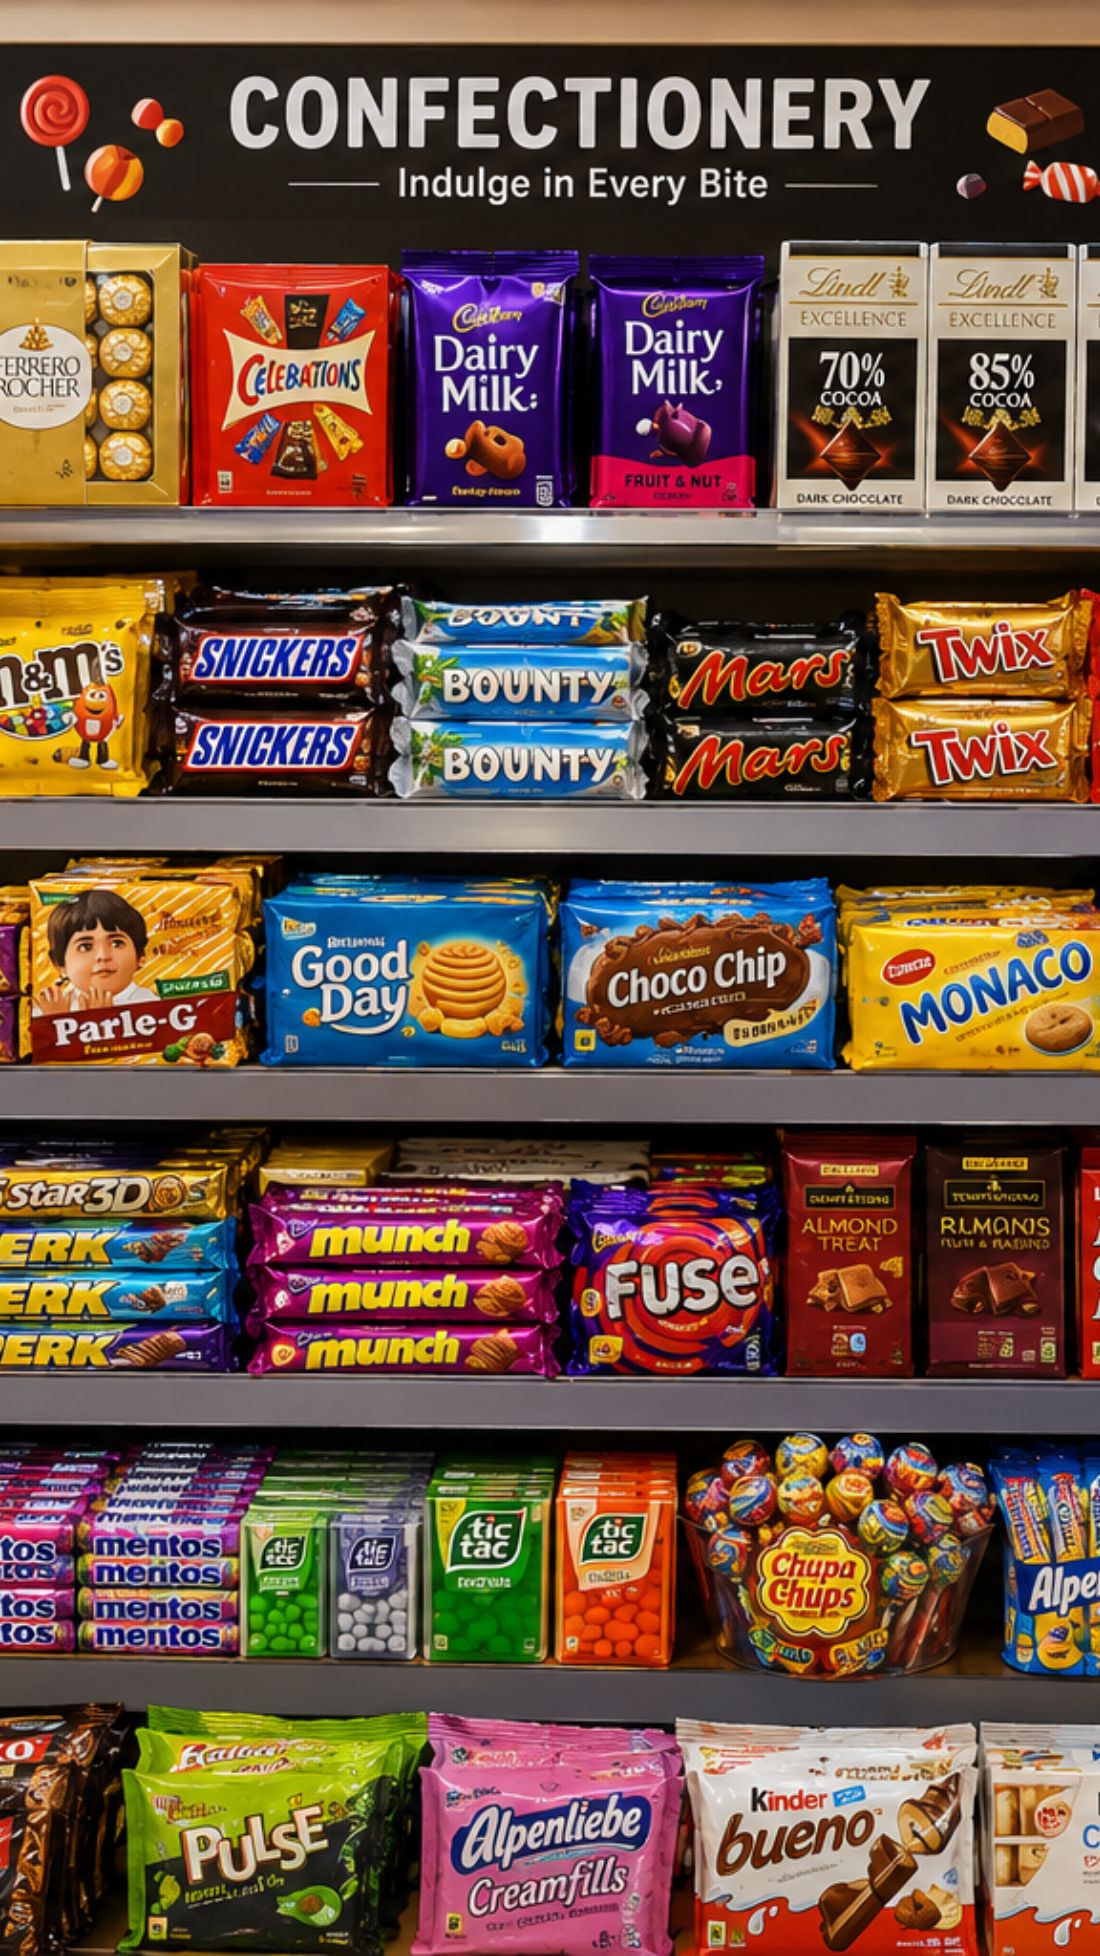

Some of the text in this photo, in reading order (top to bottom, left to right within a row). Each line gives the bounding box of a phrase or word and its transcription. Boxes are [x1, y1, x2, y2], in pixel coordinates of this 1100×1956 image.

[229, 75, 931, 150] CONFECTIONERY
[398, 166, 768, 206] Indulge in Every Bite
[800, 311, 907, 328] EXCELLENCE
[948, 312, 1057, 329] EXCELLENCE
[434, 334, 539, 378] Dairy
[625, 320, 724, 362] Dairy
[819, 351, 885, 390] 70%
[969, 352, 1035, 391] 85%
[820, 391, 882, 406] COCOA
[969, 392, 1033, 408] COCOA
[625, 475, 722, 488] FRUIT & NUT
[796, 493, 829, 505] DARK
[947, 495, 979, 506] DARK
[194, 636, 357, 679] SNICKERS
[917, 622, 1053, 683] Twix
[442, 668, 615, 704] BOUNTY
[677, 649, 852, 709] Mars
[191, 725, 355, 766] SNICKERS
[443, 747, 615, 782] BOUNTY
[673, 734, 851, 795] Mars
[912, 723, 1058, 786] Twix
[292, 940, 411, 988] Good
[607, 964, 707, 1008] Choco
[714, 945, 787, 989] Chip
[320, 984, 409, 1035] Day
[899, 941, 1092, 1045] MONACO
[53, 1003, 198, 1046] Parle-G
[309, 1218, 471, 1258] munch
[801, 1217, 899, 1235] ALMOND
[817, 1236, 883, 1252] TREAT
[307, 1274, 469, 1314] munch
[0, 1334, 117, 1367] ERK
[305, 1331, 460, 1370] munch
[468, 1513, 513, 1540] tic
[591, 1535, 634, 1555] tac
[598, 1517, 637, 1539] tic
[94, 1535, 222, 1559] mentos
[459, 1534, 510, 1560] tac
[94, 1561, 222, 1585] mentos
[771, 1552, 857, 1585] Chupa
[94, 1595, 222, 1621] mentos
[768, 1579, 857, 1618] Chups
[1028, 1565, 1100, 1616] Alpe
[95, 1624, 221, 1648] mentos
[751, 1787, 828, 1812] Kinder
[180, 1804, 330, 1885] PULSE
[461, 1793, 643, 1869] Alpenliebe
[716, 1810, 876, 1877] bueno
[469, 1856, 629, 1918] Creamfills
